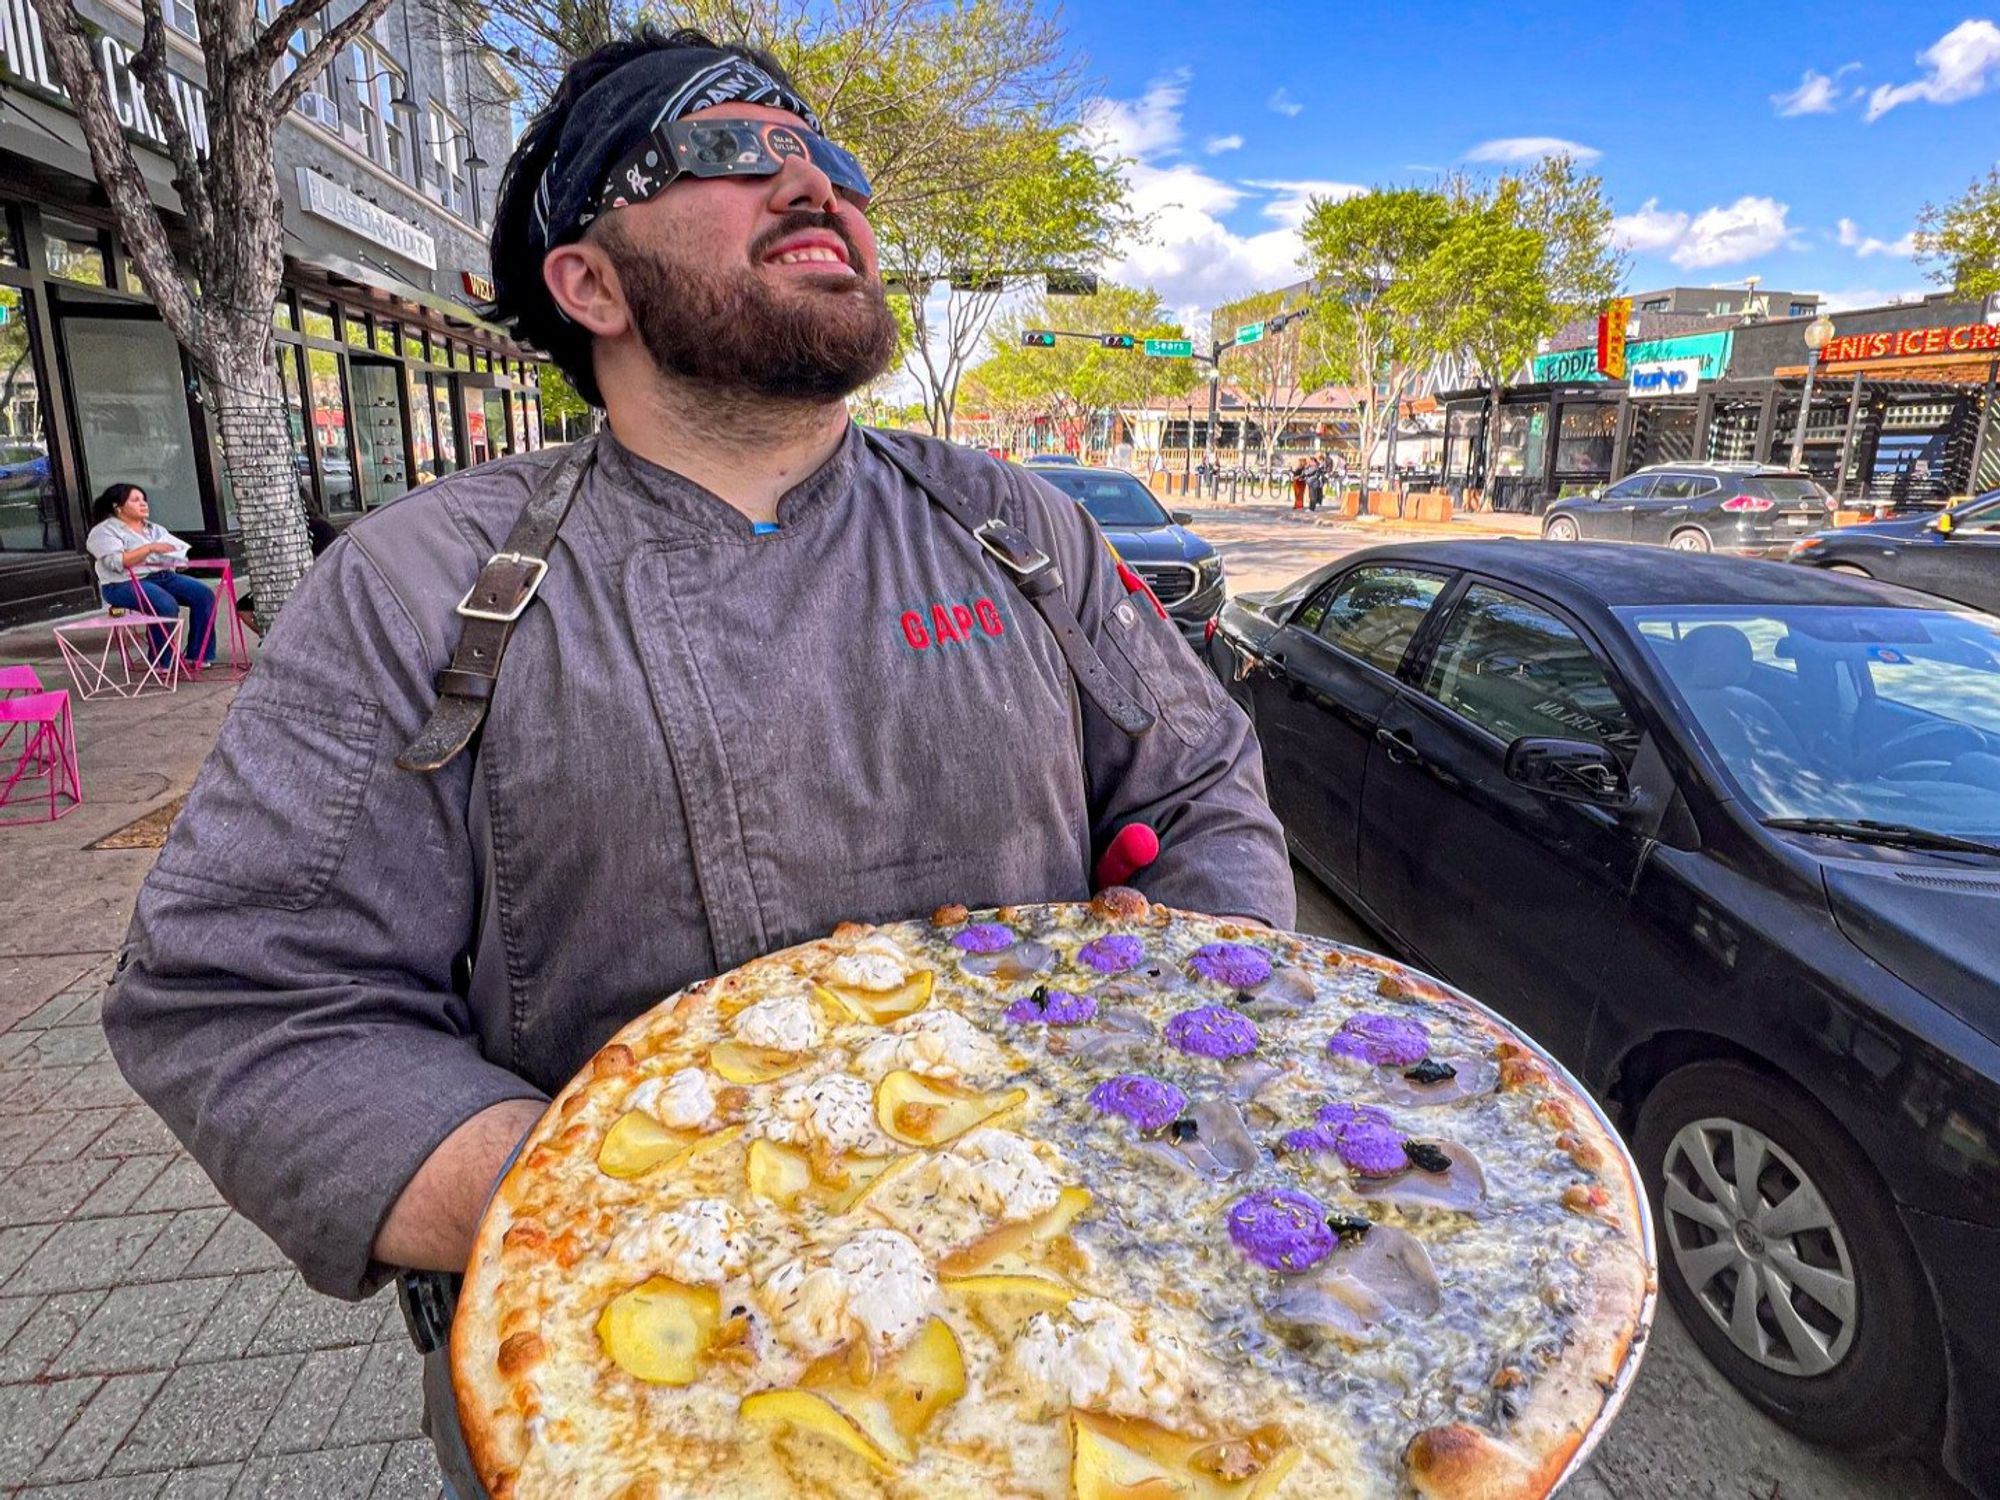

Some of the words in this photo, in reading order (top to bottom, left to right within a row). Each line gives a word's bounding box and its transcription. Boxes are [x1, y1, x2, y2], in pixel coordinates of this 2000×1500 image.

[102, 36, 210, 160] CRM
[1154, 341, 1185, 351] Sears
[1820, 333, 1891, 361] ENI'S
[1894, 328, 1945, 355] ICE
[1949, 323, 2000, 350] CR
